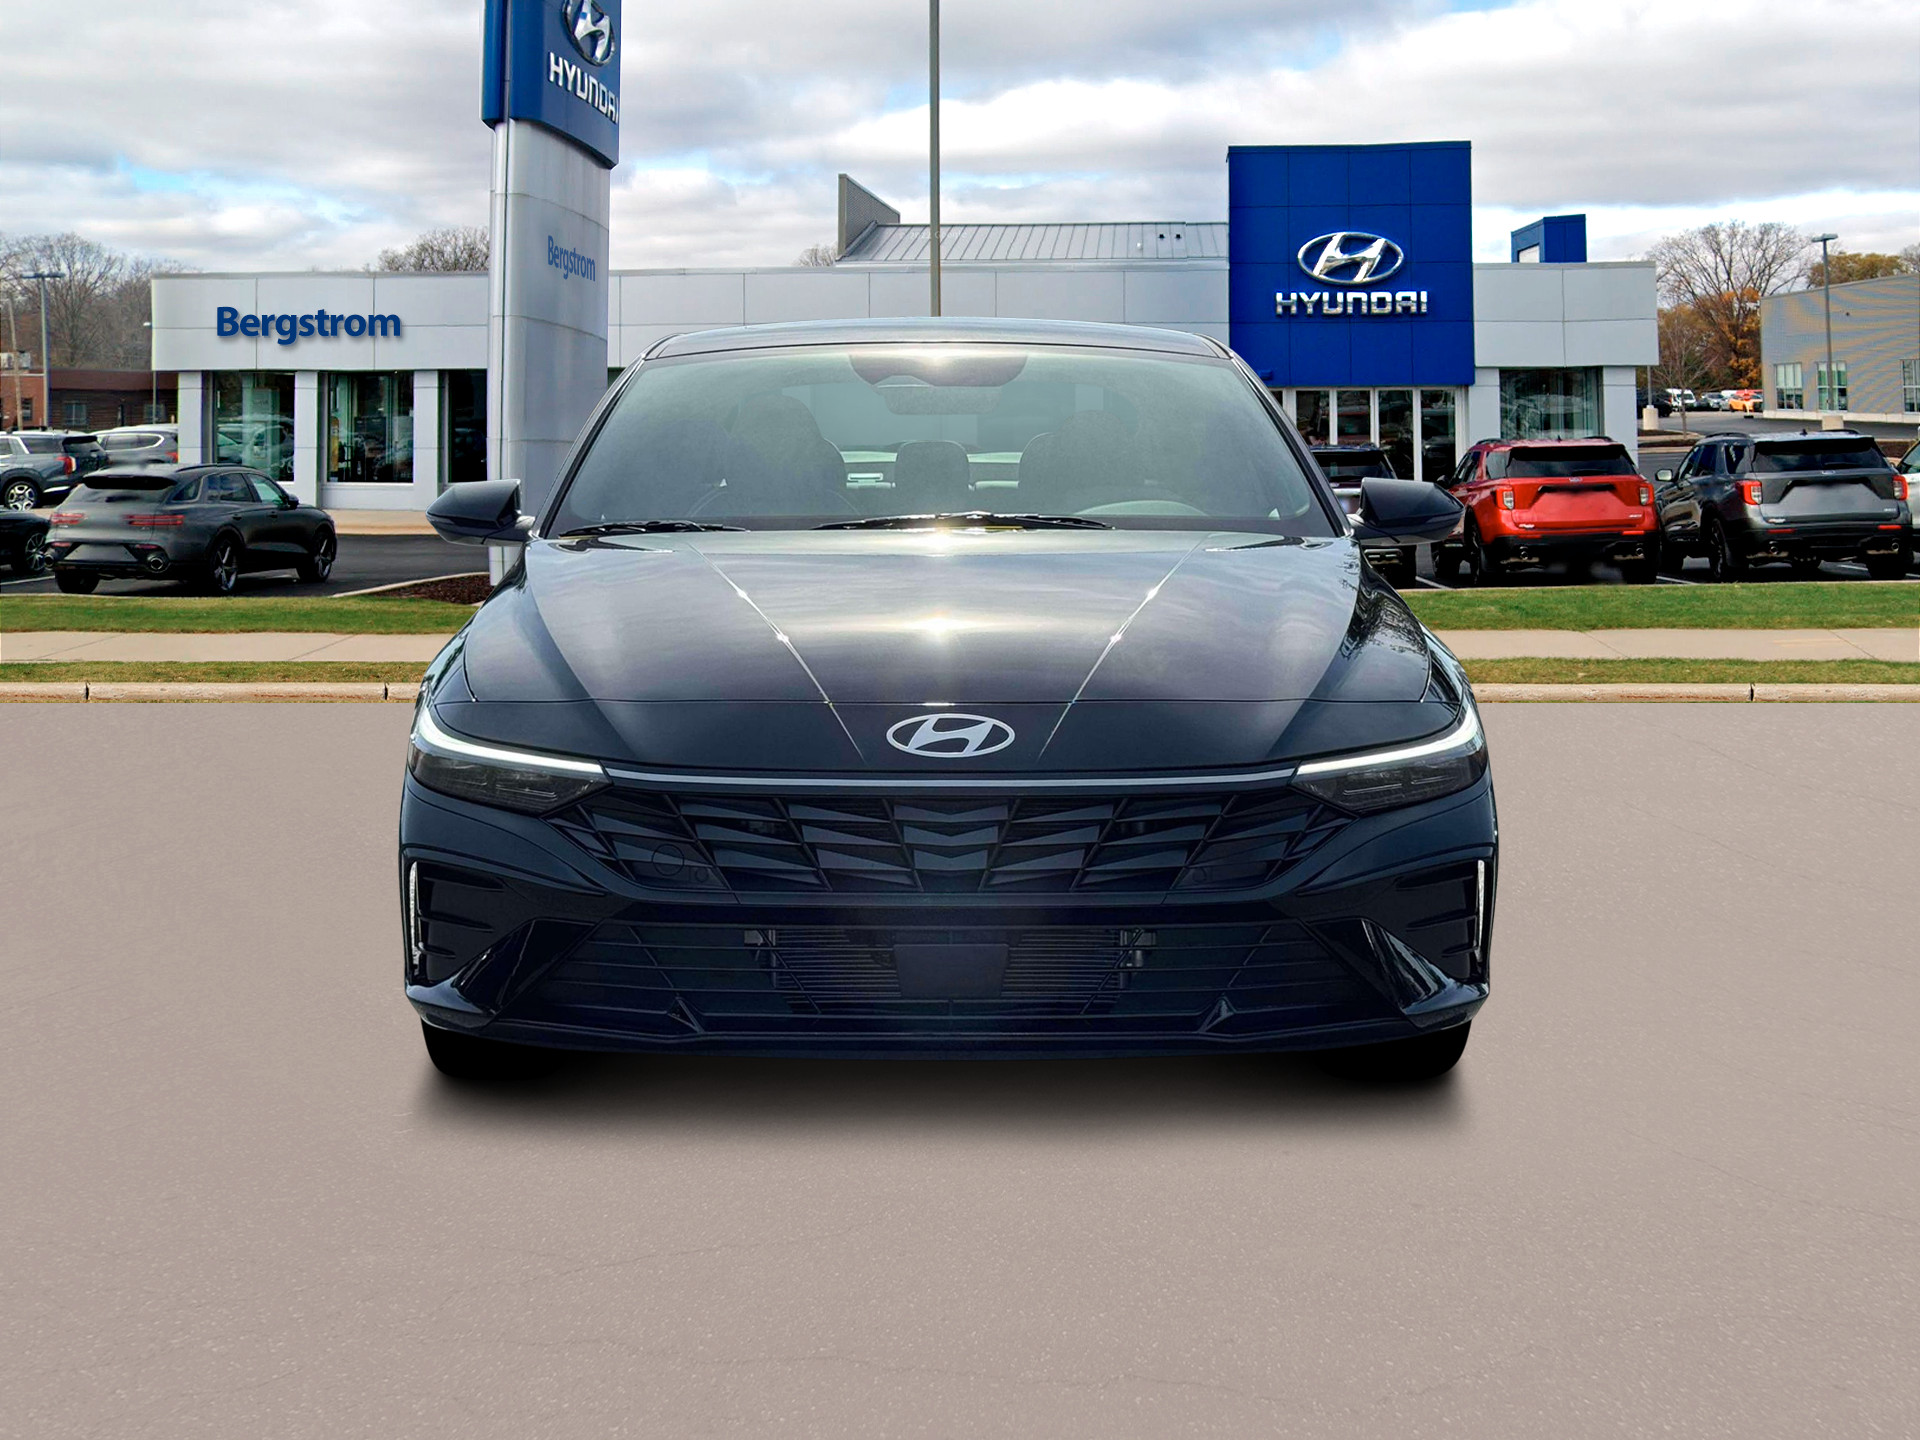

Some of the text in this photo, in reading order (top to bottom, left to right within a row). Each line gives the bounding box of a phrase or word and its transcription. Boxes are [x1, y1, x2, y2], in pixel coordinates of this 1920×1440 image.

[549, 52, 618, 124] HYUNDAI
[547, 235, 596, 282] Bergstrom
[1275, 291, 1428, 315] HYUNDAI
[217, 306, 401, 345] Bergstrom
